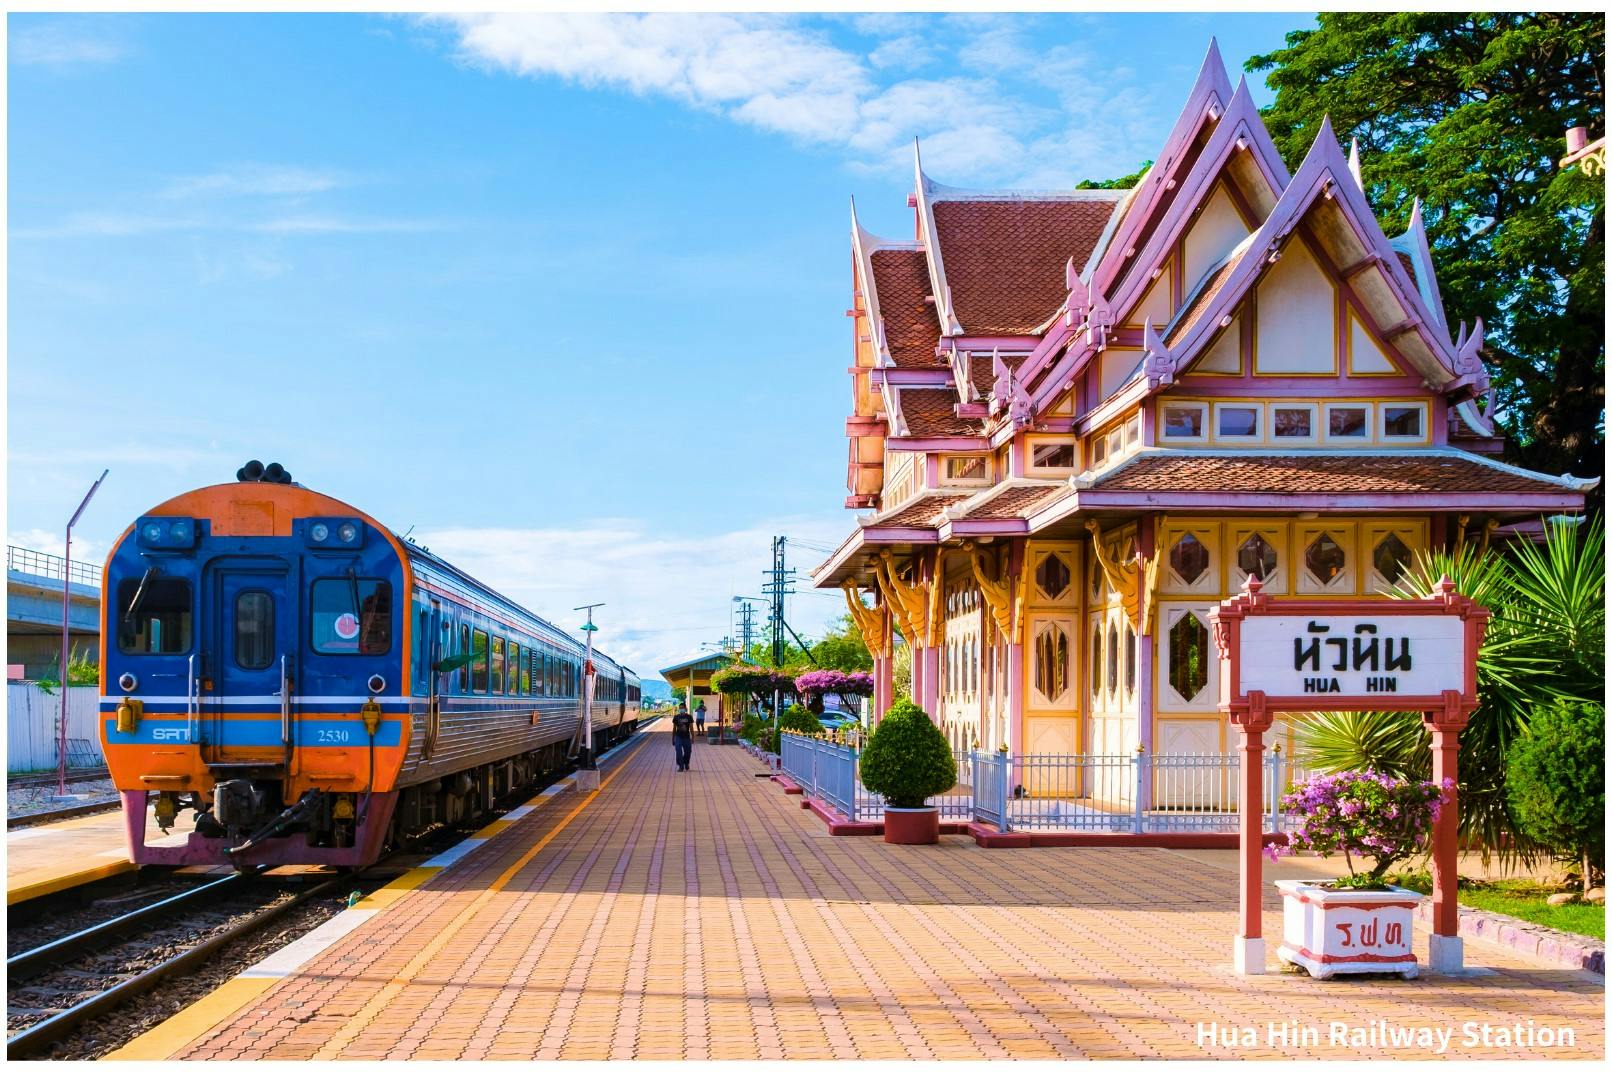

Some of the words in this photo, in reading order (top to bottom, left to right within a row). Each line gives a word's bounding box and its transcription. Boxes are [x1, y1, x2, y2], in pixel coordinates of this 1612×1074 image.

[1294, 620, 1412, 672] หัวหิน
[1304, 677, 1341, 693] HUA
[1366, 677, 1397, 693] HIN
[152, 728, 191, 741] SRT
[317, 729, 349, 743] 2530
